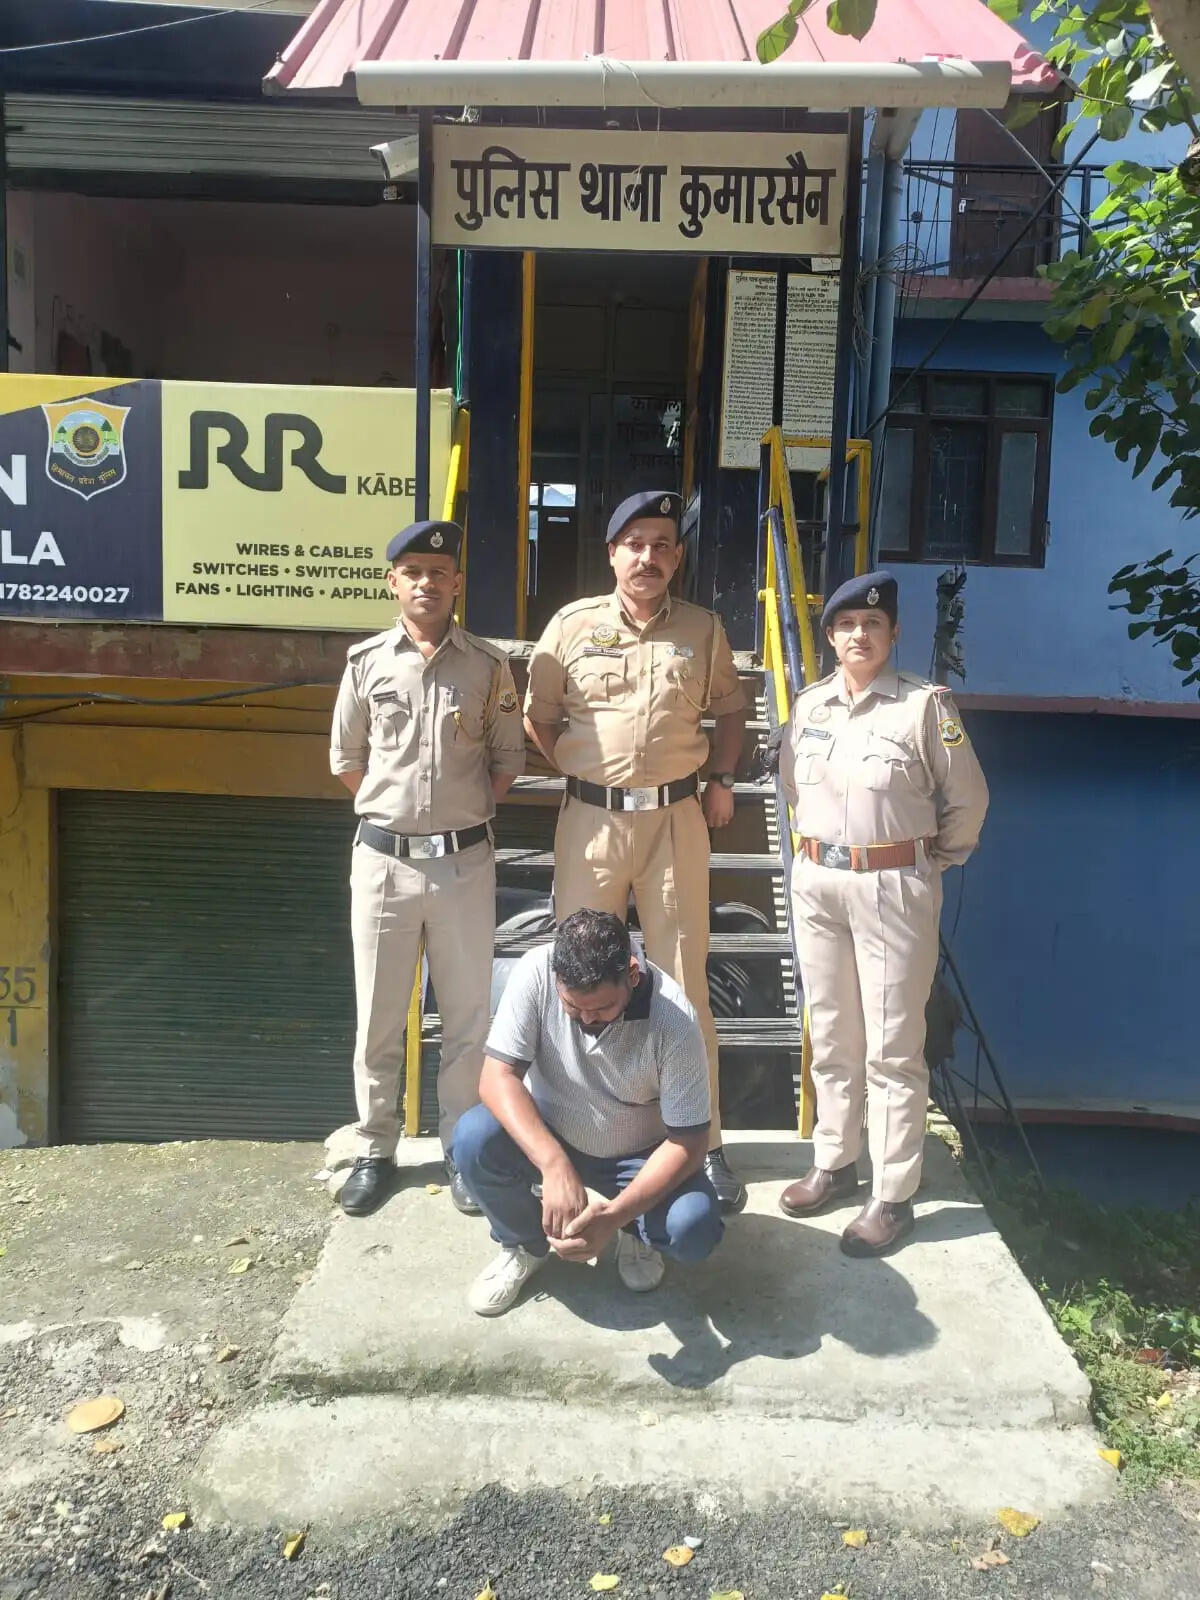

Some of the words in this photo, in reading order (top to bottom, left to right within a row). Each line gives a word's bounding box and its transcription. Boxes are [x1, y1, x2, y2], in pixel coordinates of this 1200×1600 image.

[450, 145, 571, 231] पुलिस
[579, 162, 668, 223] थाना
[678, 151, 837, 239] कुमारसैन
[178, 410, 346, 494] RR
[357, 472, 416, 496] KĀBE
[1, 530, 66, 566] LA
[236, 543, 290, 557] WIRES
[294, 545, 305, 557] &
[309, 545, 373, 559] CABLES
[192, 562, 279, 576] SWITCHES
[175, 582, 220, 595] FANS
[236, 584, 314, 598] LIGHTING
